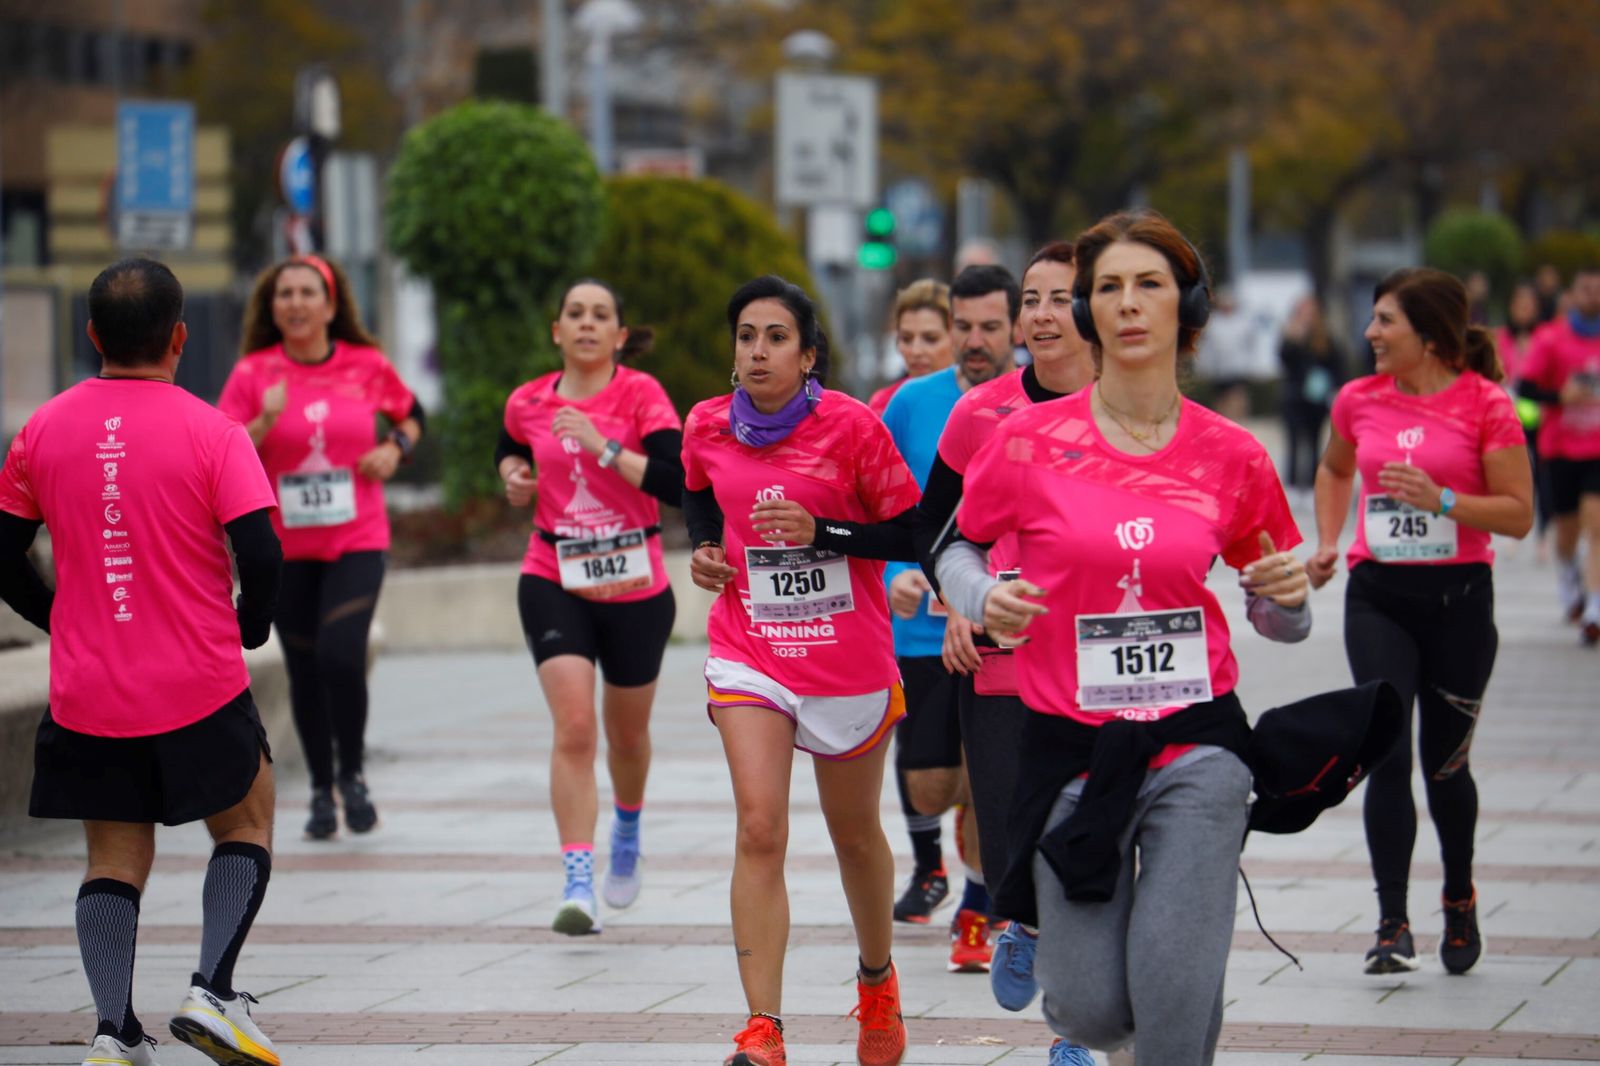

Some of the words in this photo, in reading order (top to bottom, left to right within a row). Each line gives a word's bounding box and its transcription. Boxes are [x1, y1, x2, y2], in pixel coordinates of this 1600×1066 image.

[96, 451, 119, 459] cajasur
[1389, 516, 1428, 538] 245
[582, 555, 628, 579] 1842
[769, 567, 826, 596] 1250
[772, 646, 808, 658] 2023
[1111, 642, 1175, 675] 1512
